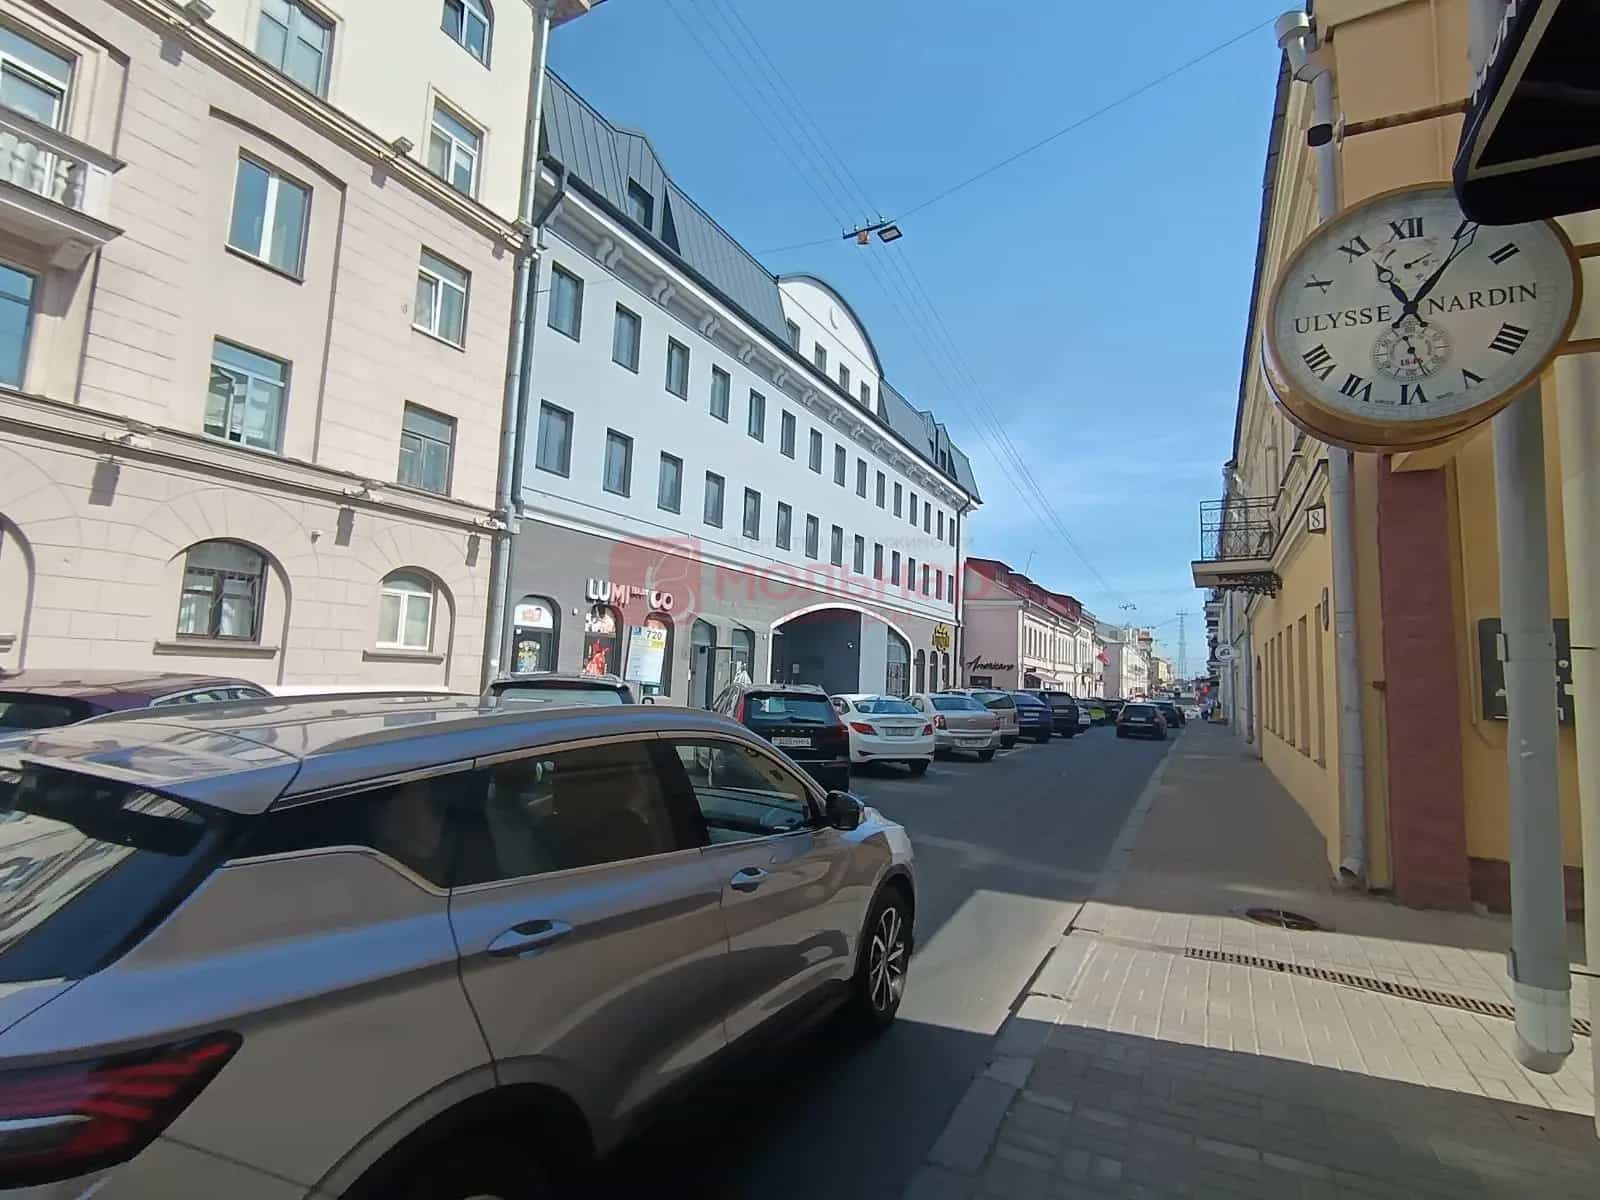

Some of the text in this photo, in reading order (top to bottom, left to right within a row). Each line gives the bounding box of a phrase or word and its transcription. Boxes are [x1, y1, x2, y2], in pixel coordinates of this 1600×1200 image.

[1385, 217, 1424, 244] XII
[1337, 235, 1372, 264] XI
[1488, 242, 1521, 265] II
[1303, 273, 1334, 294] X
[1294, 282, 1537, 334] ULYSSE NARDIN
[1488, 322, 1530, 356] IIII
[1302, 343, 1337, 381] VIII
[1337, 373, 1373, 403] VII
[1461, 368, 1488, 390] V
[1399, 383, 1430, 406] VI
[1311, 511, 1320, 528] 8
[587, 578, 631, 606] LUMI
[645, 630, 663, 640] 720
